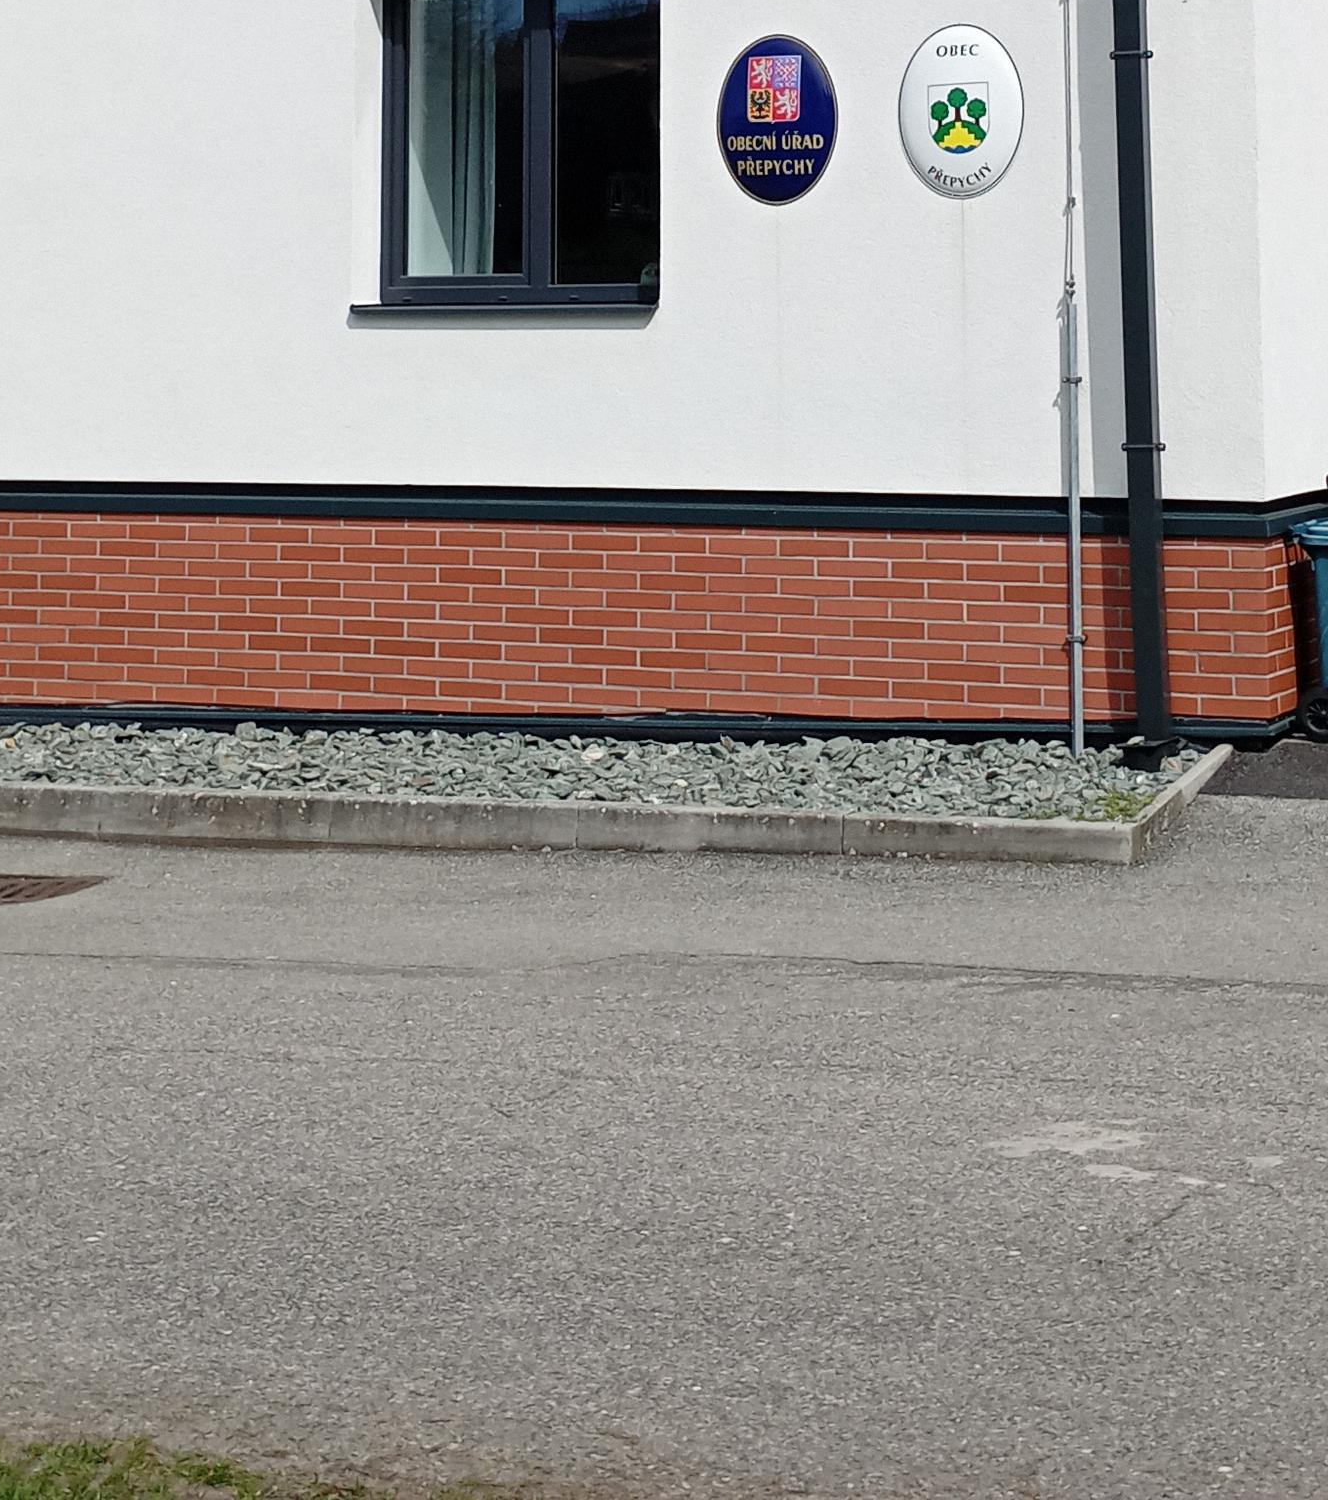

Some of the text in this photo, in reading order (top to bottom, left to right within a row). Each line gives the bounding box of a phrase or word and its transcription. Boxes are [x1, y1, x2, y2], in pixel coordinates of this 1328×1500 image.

[936, 44, 979, 57] OBEC
[727, 129, 824, 151] OBECNÍ ÚŘAD
[737, 156, 815, 176] PŘEPYCHY
